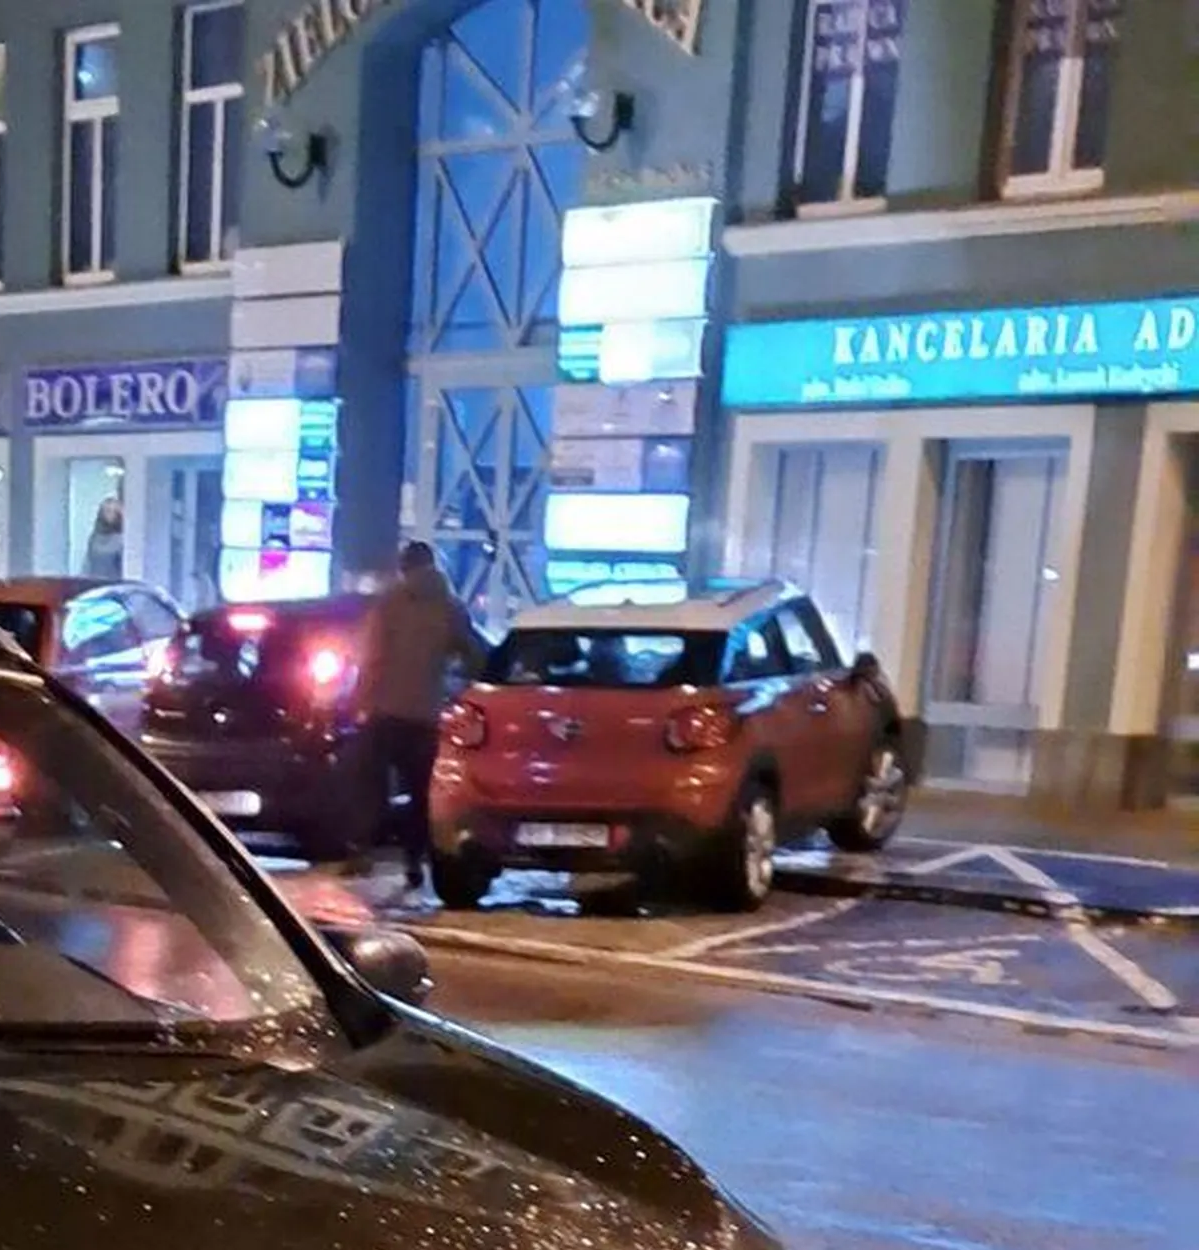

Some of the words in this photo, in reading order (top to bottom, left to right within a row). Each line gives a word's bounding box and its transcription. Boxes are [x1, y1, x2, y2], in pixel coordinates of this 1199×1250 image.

[832, 312, 1098, 365] KANCELARIA
[1133, 306, 1196, 352] AD
[26, 369, 197, 420] BOLERO
